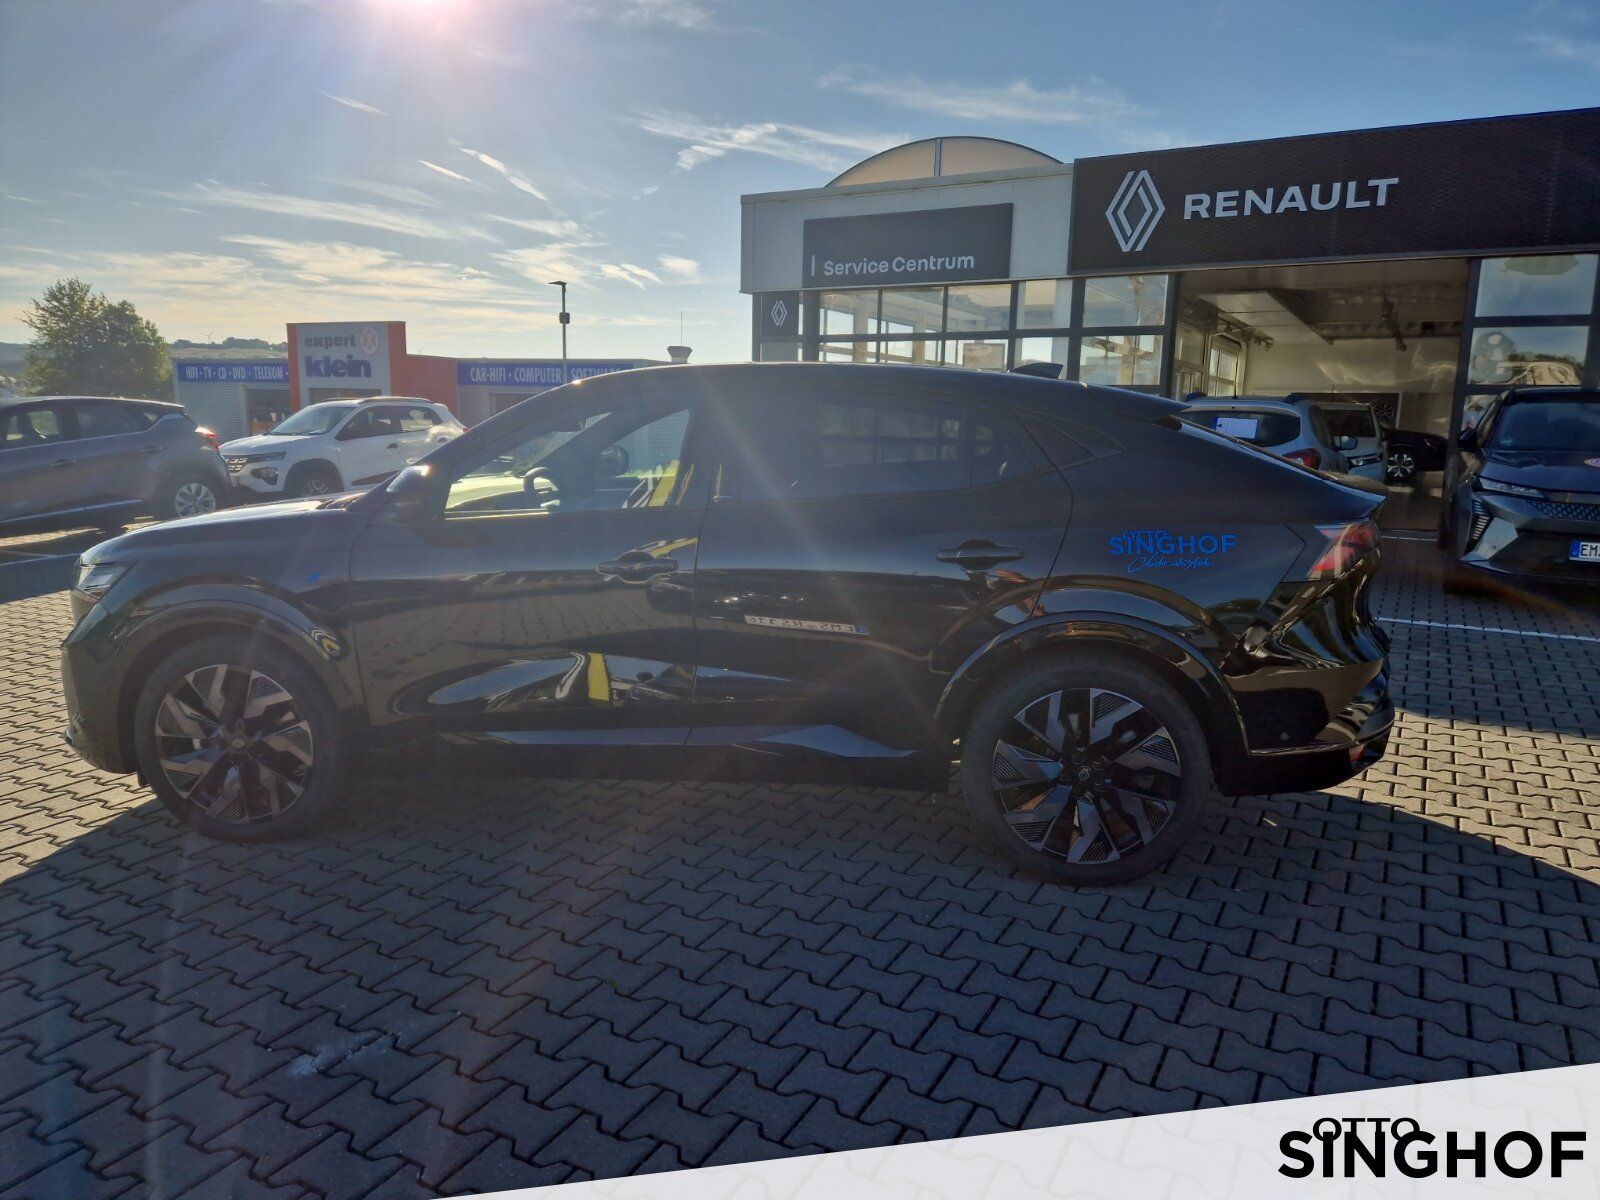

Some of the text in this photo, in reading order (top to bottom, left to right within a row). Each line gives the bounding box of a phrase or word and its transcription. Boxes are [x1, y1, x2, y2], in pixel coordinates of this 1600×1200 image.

[1183, 177, 1399, 220] RENAULT
[823, 255, 975, 276] Service Centrum
[303, 334, 356, 349] expert
[185, 366, 284, 380] HIFI TV CD DVD TELEKOM
[304, 354, 372, 378] klein
[470, 367, 506, 382] CAR-HIFI
[514, 368, 562, 383] COMPUTER
[1109, 533, 1238, 555] SINGHOF
